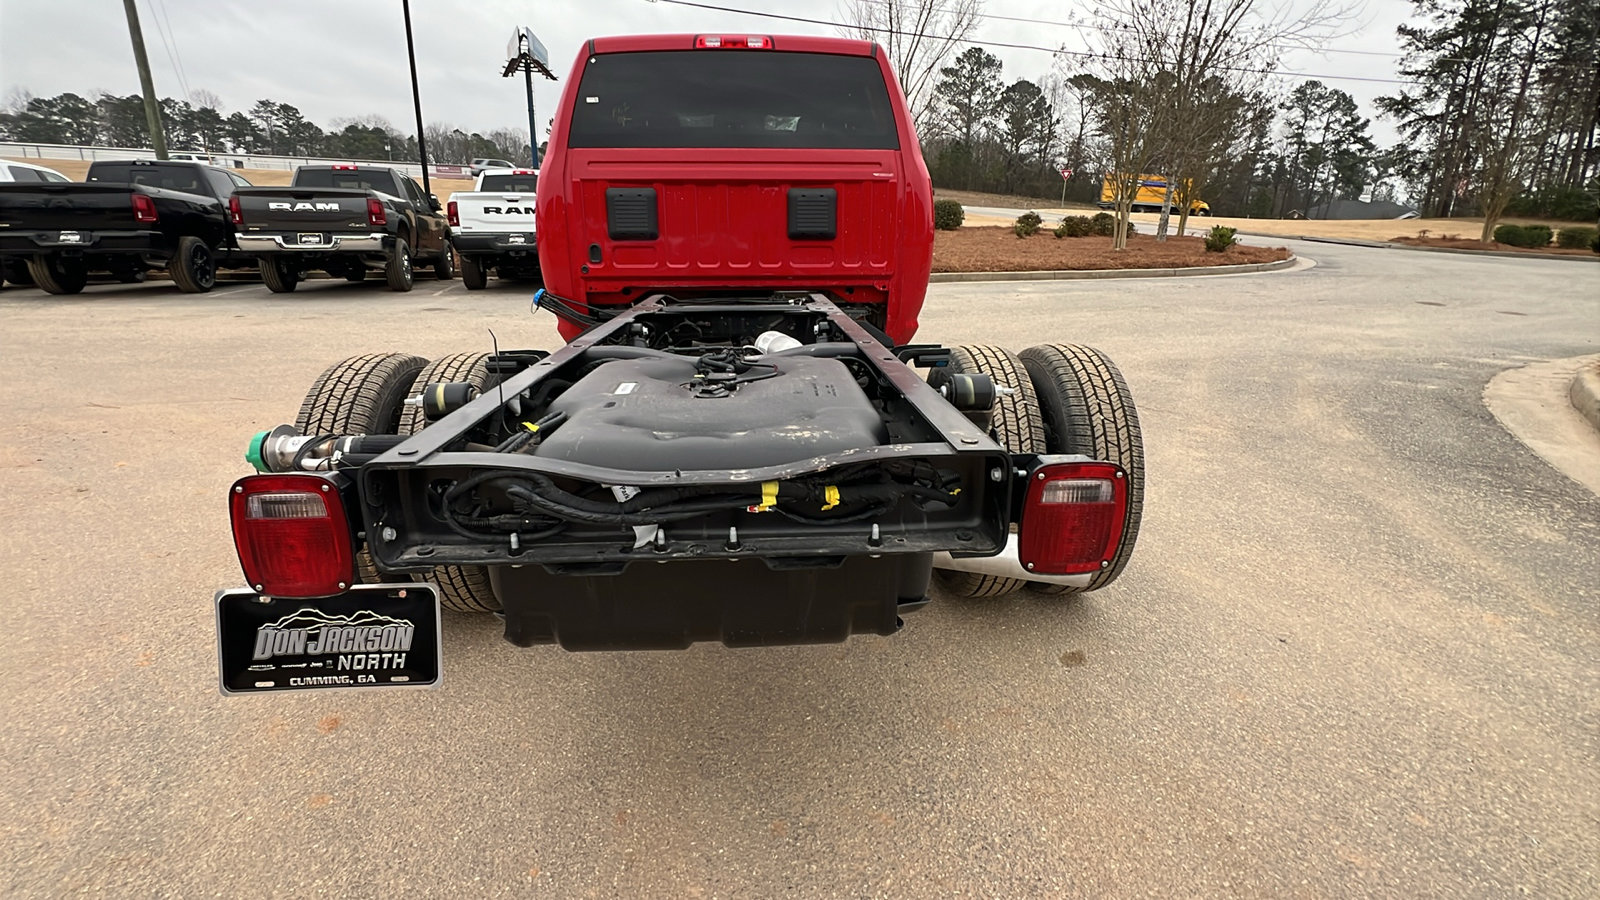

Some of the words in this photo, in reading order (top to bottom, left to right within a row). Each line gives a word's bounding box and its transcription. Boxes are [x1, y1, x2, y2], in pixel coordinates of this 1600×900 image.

[268, 202, 340, 212] RAM
[252, 628, 307, 660] DON
[308, 626, 414, 653] JACKSON
[338, 653, 407, 671] NORTH
[289, 675, 354, 687] CUMMING,
[357, 674, 377, 684] GA
